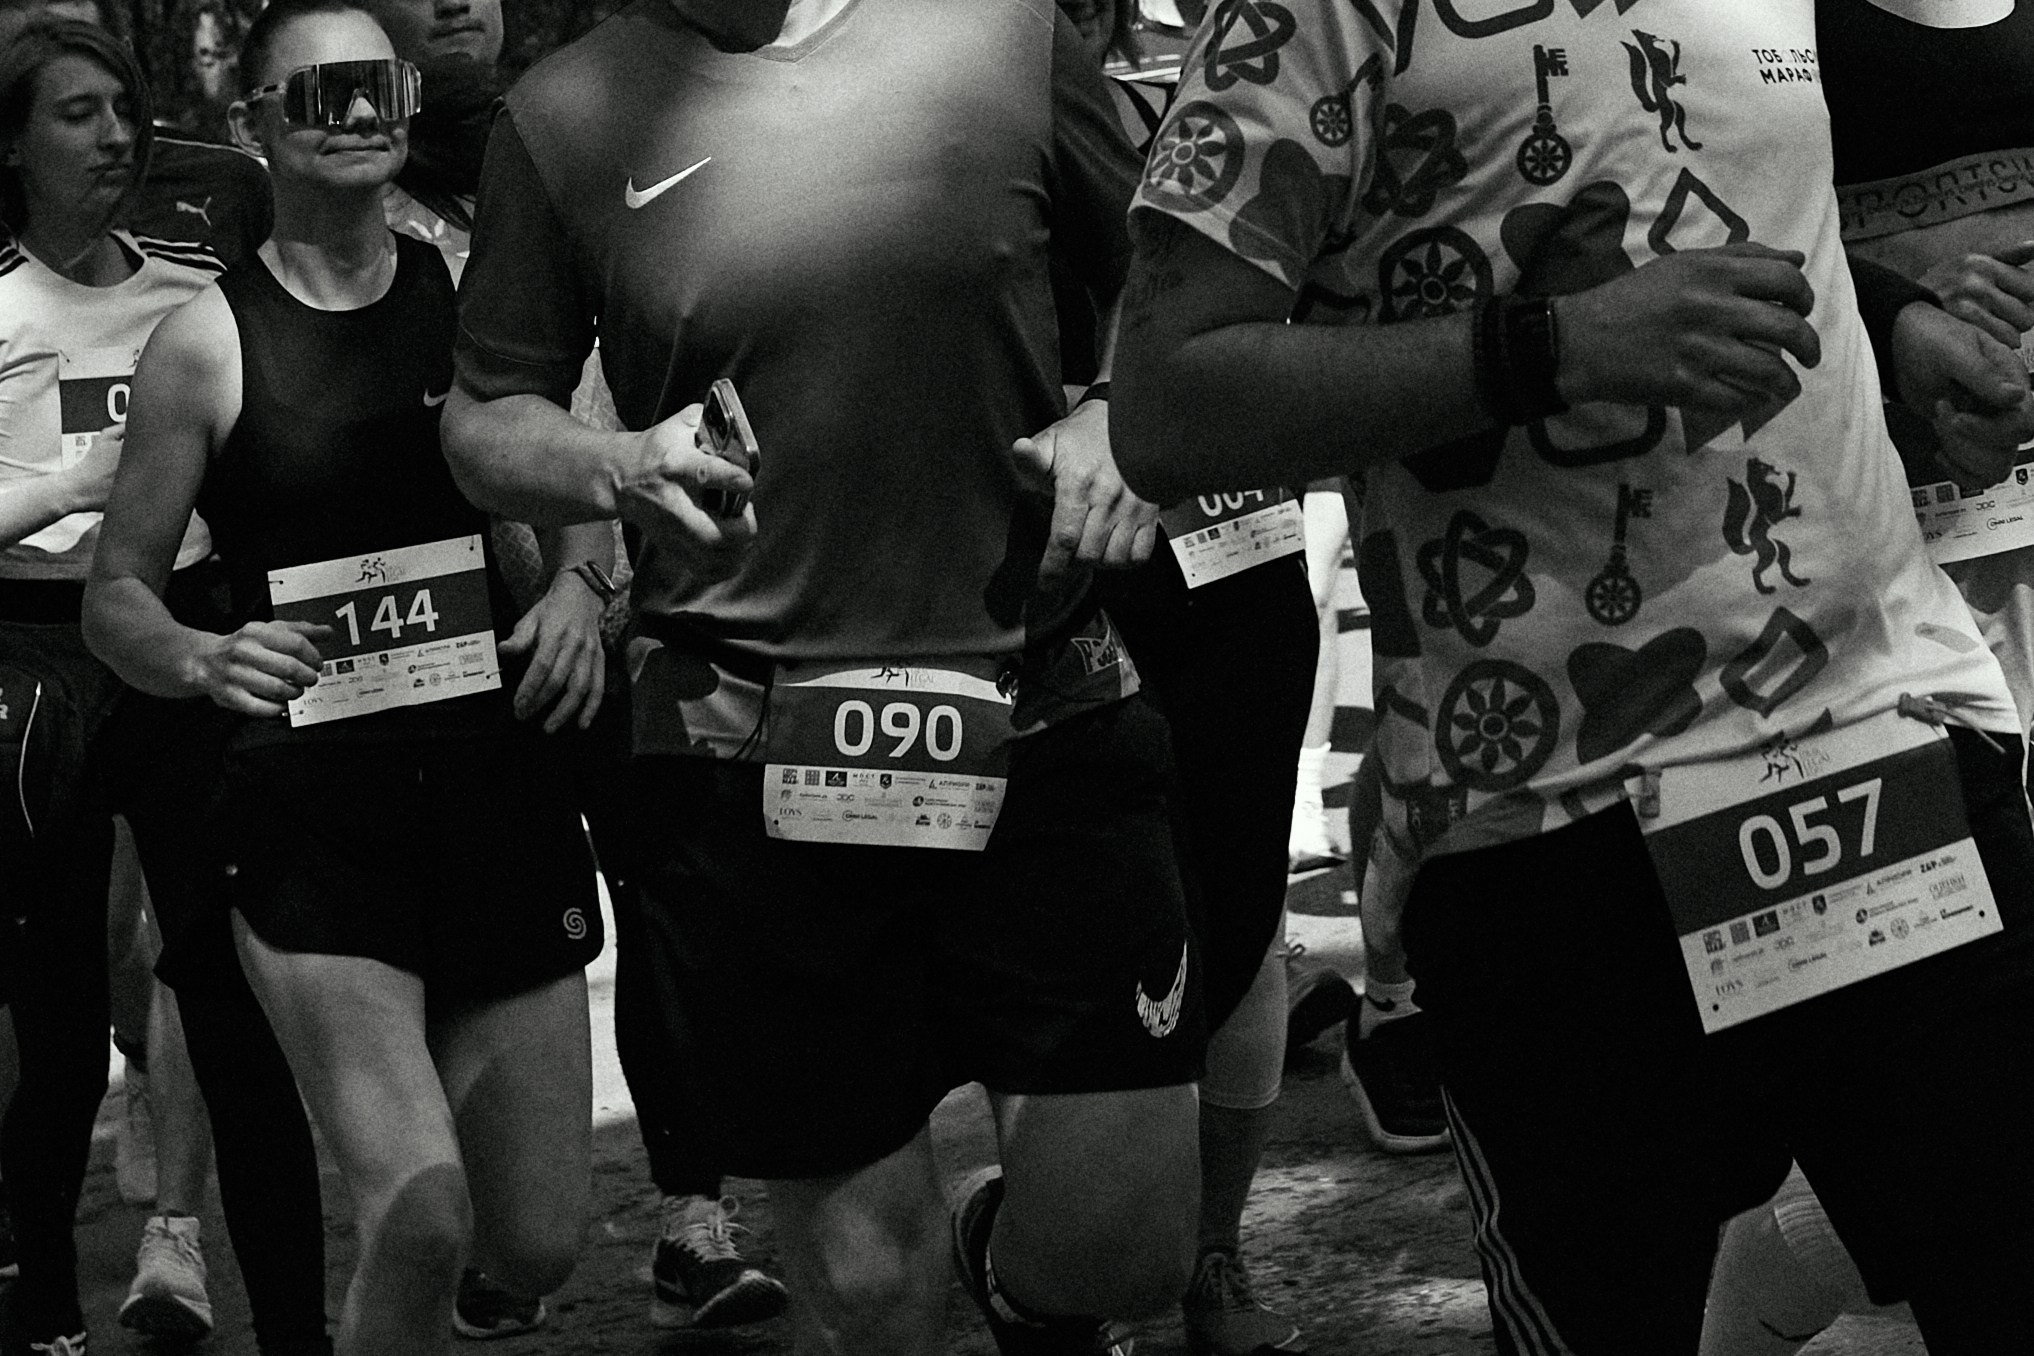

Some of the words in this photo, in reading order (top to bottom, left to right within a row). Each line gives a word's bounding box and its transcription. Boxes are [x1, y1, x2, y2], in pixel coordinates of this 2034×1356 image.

[1751, 48, 1817, 65] ТОБОЛЬС
[1759, 67, 1820, 85] МАРАФ
[1837, 157, 2034, 234] PORTS
[335, 588, 440, 647] 144
[834, 699, 963, 762] 090
[1738, 777, 1882, 891] 057
